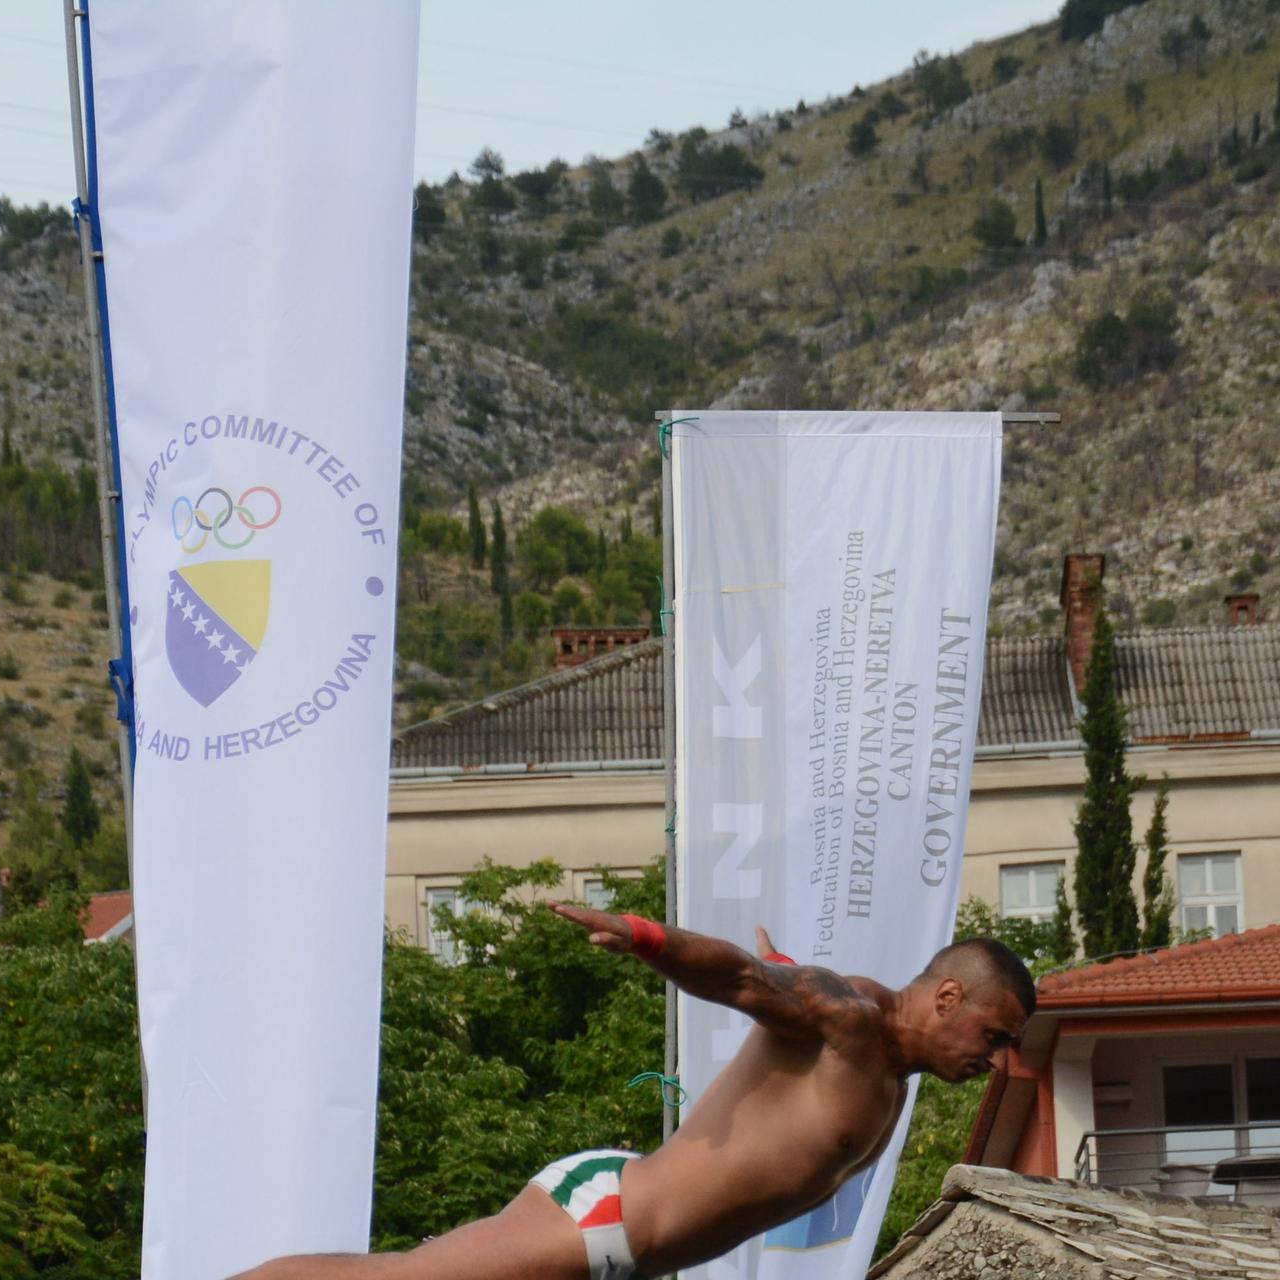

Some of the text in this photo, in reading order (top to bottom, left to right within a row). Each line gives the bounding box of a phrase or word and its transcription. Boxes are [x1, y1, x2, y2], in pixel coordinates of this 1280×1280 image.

[184, 414, 361, 499] COMMITTEE
[354, 502, 386, 545] OF
[147, 729, 191, 762] AND
[203, 633, 377, 761] HERZEGOVINA
[809, 606, 833, 886] Bosnia and Herzegovina
[812, 530, 866, 958] Federation of Bosnia and Herzegovina
[846, 567, 896, 920] HERZEGOVINA-NERETVA
[886, 681, 919, 801] CANTON
[920, 607, 971, 888] GOVERNMENT
